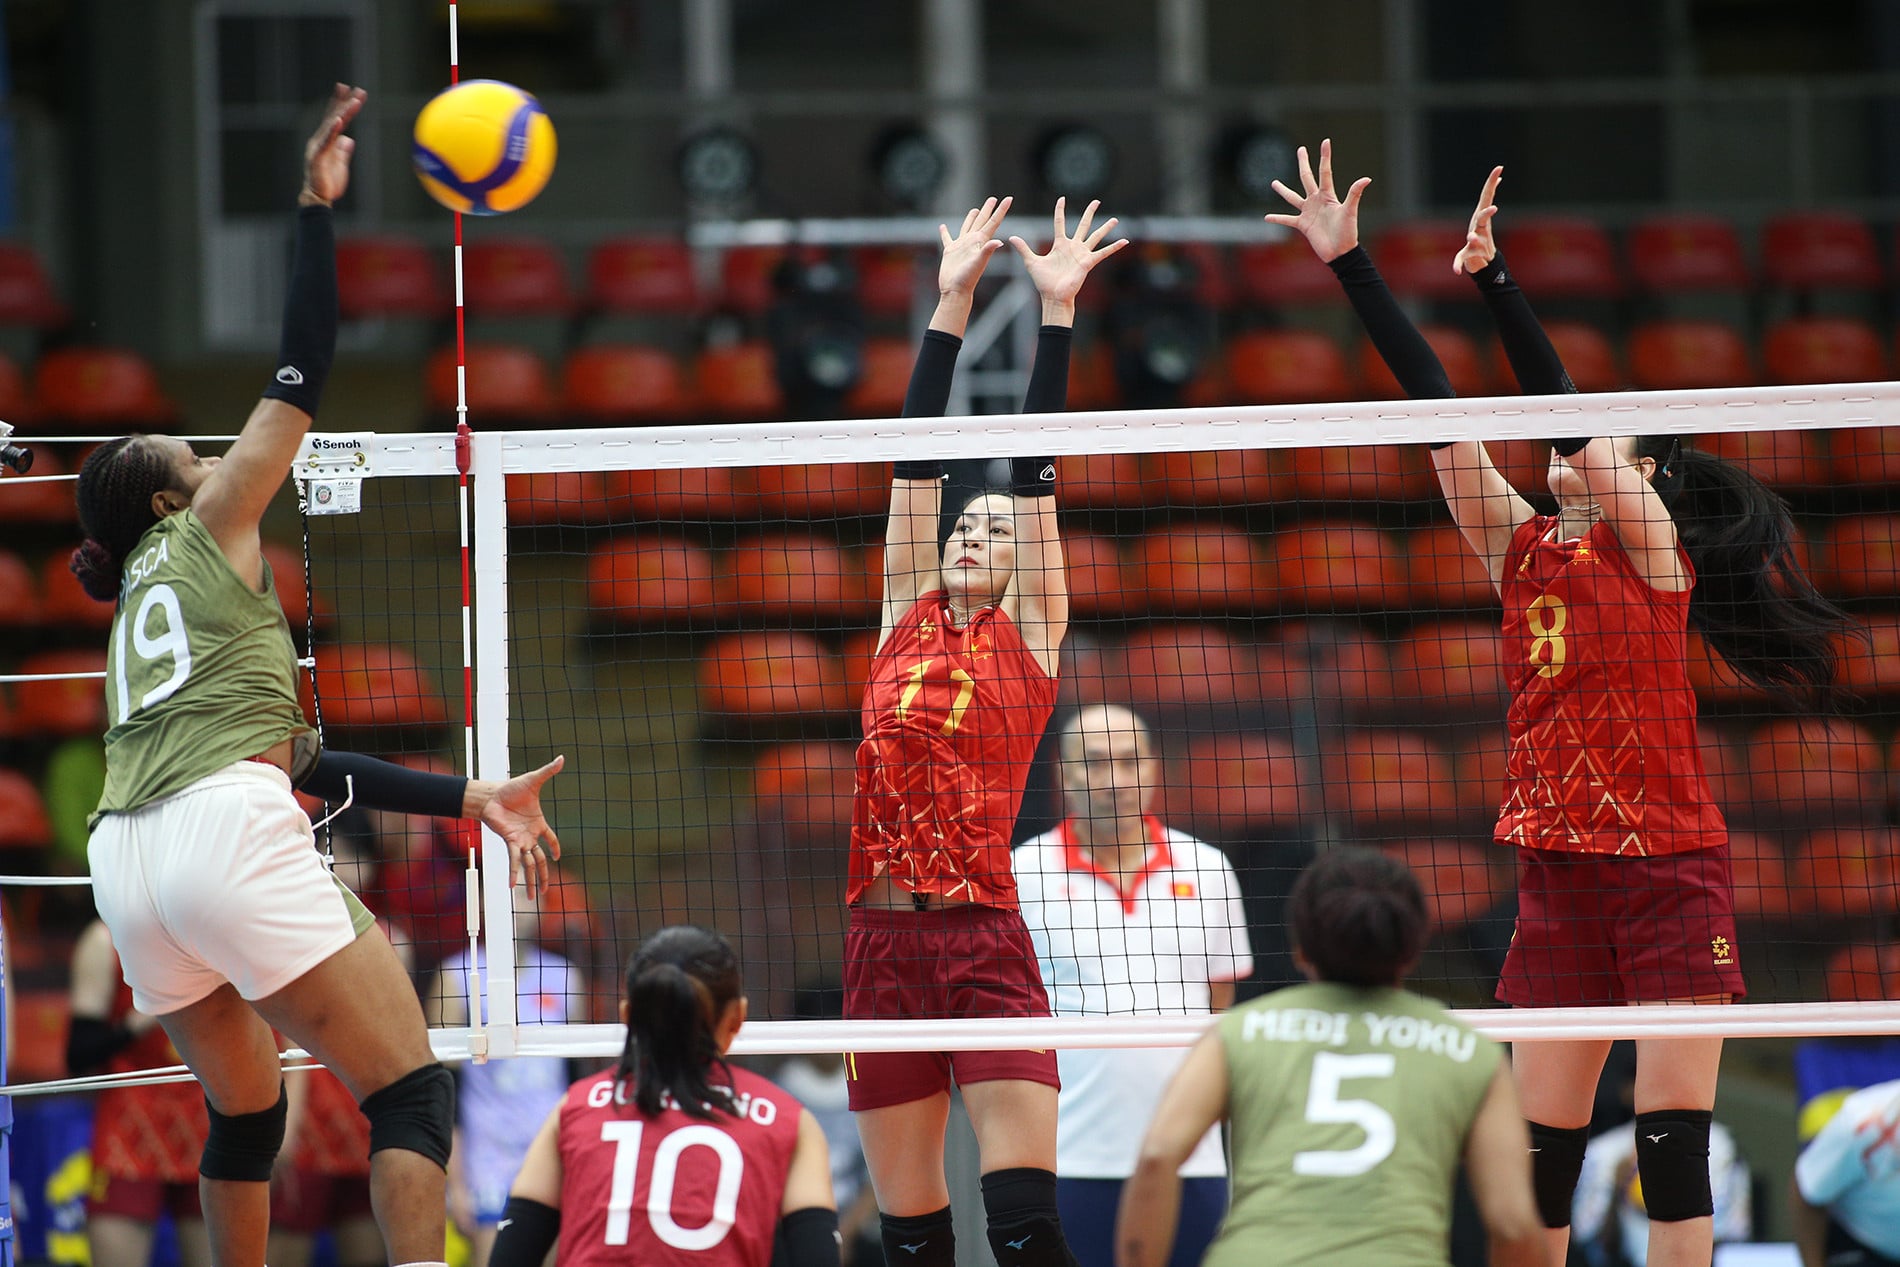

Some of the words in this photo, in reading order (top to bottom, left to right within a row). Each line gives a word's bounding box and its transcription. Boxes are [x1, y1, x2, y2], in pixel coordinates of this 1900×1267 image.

[322, 439, 361, 450] Senoh
[115, 583, 192, 726] 19
[1526, 594, 1567, 678] 8
[1363, 1010, 1477, 1063] YOKU
[1292, 1051, 1397, 1177] 5
[600, 1120, 744, 1251] 10
